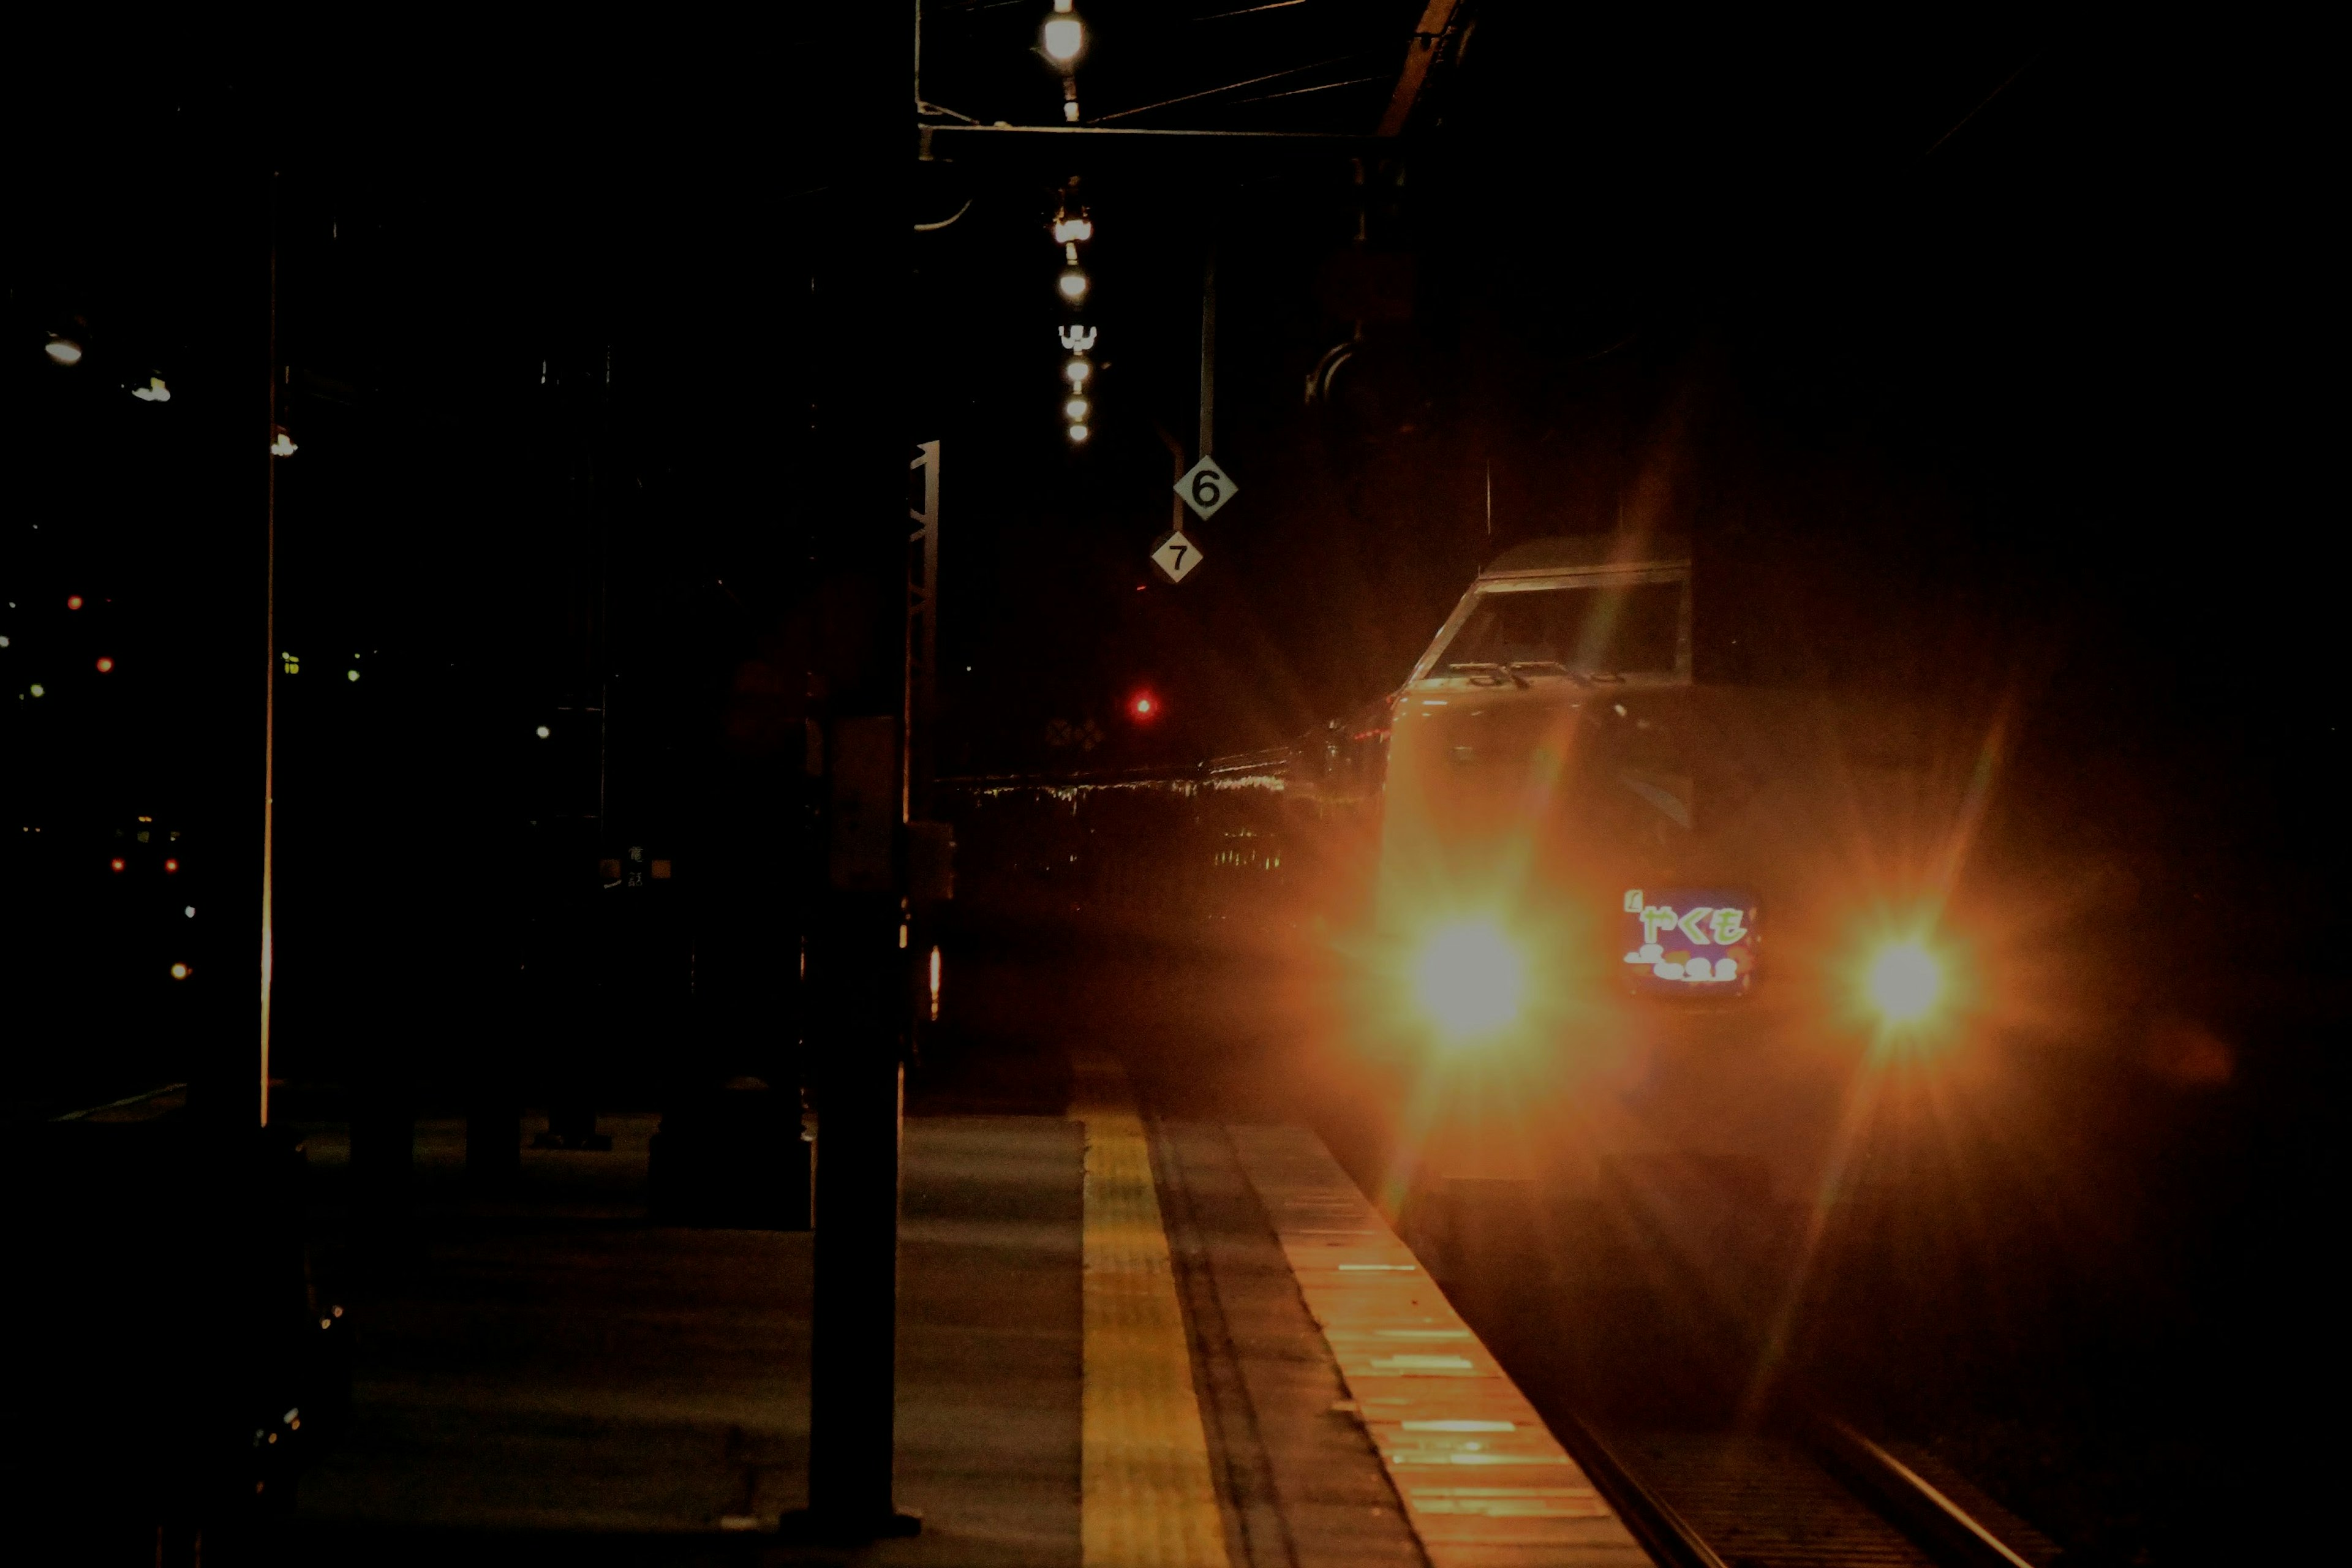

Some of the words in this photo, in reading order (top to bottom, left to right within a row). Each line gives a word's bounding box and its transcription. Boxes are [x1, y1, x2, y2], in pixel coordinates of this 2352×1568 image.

[1192, 470, 1219, 507] 6
[1170, 546, 1187, 570] 7
[1640, 905, 1747, 945] やくも
